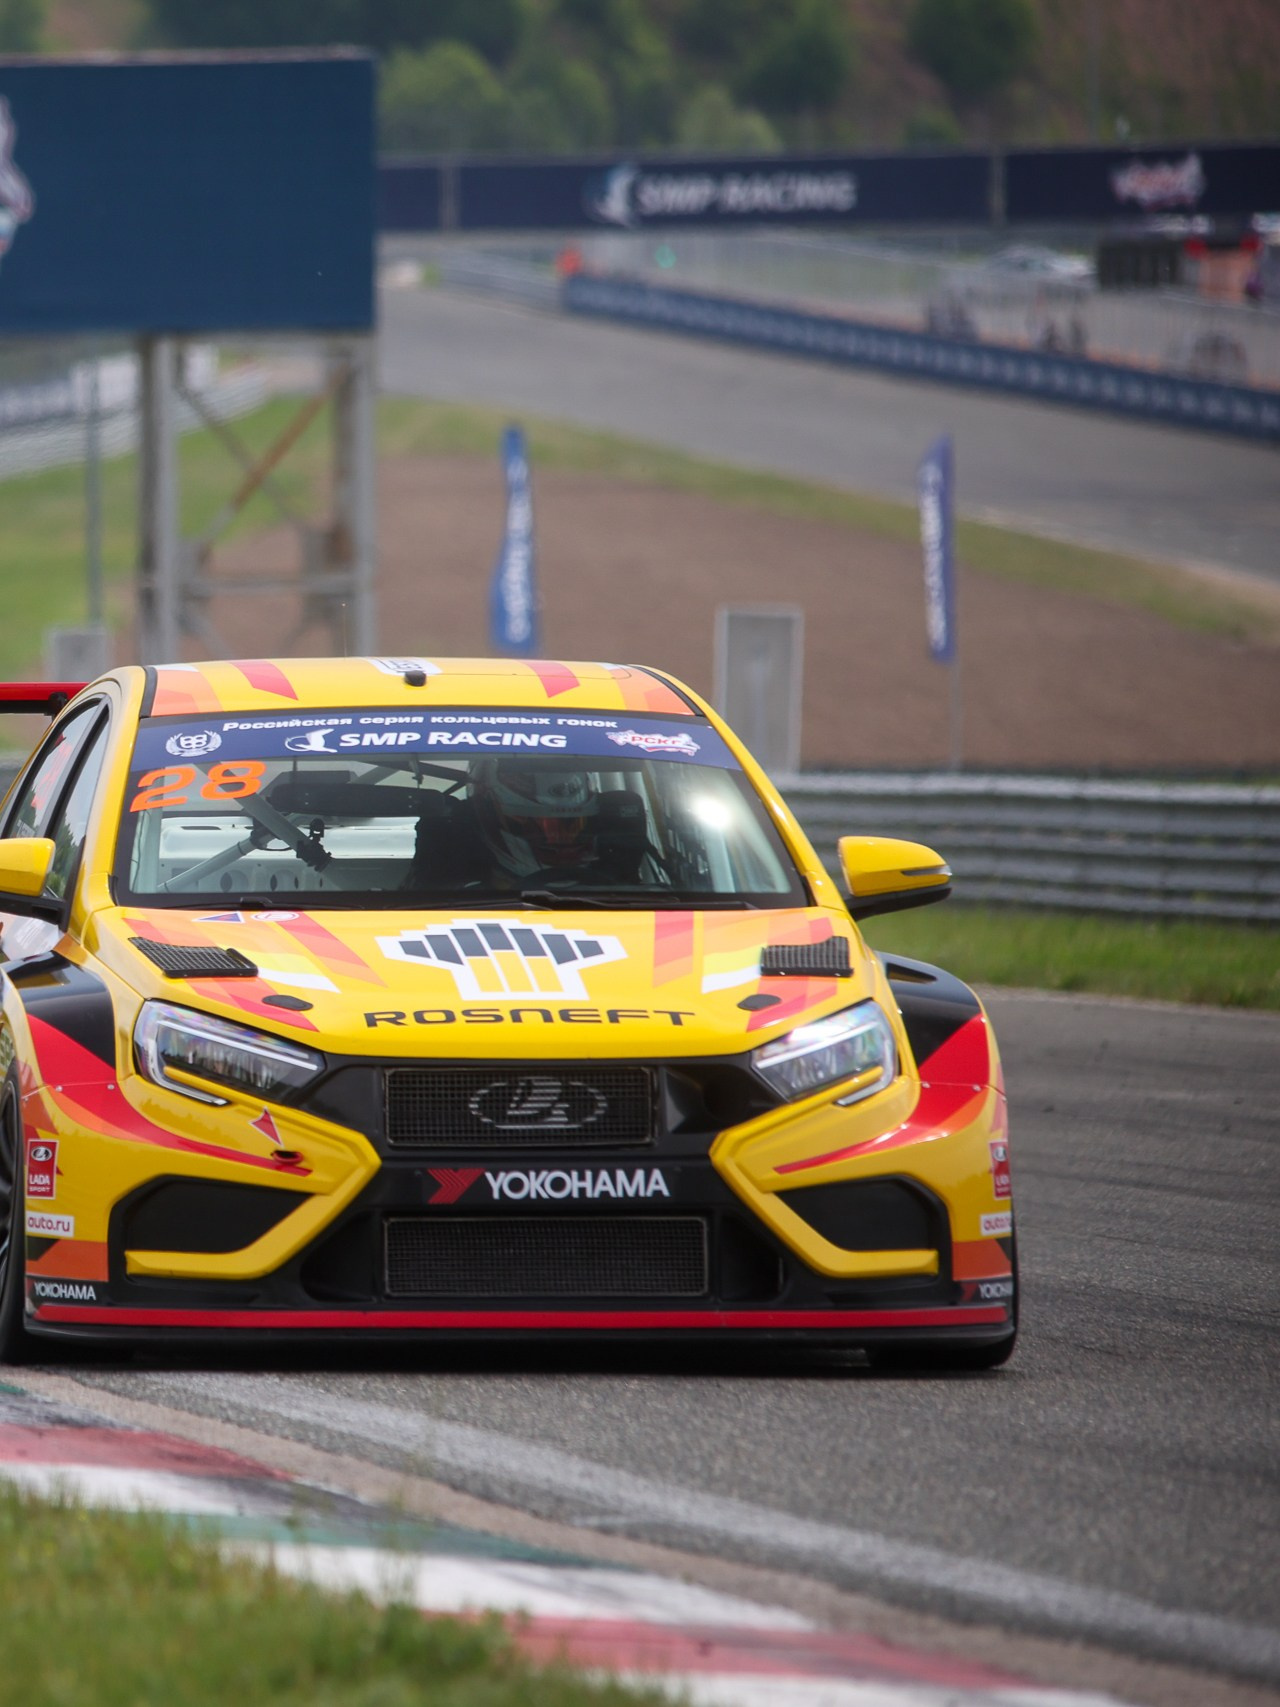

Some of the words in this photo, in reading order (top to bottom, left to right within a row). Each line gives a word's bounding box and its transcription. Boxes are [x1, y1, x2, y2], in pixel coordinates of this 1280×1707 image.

[222, 716, 352, 731] Российская
[359, 716, 423, 726] серия
[431, 716, 550, 725] кольцевых
[557, 718, 618, 728] гонок
[339, 732, 421, 746] SMP
[428, 731, 567, 747] RACING
[130, 760, 267, 812] 28
[364, 1007, 695, 1028] ROSNEFT
[29, 1174, 50, 1185] LADA
[484, 1168, 670, 1200] YOKOHAMA
[27, 1215, 70, 1232] auto.ru
[34, 1282, 96, 1300] YOKOHAMA
